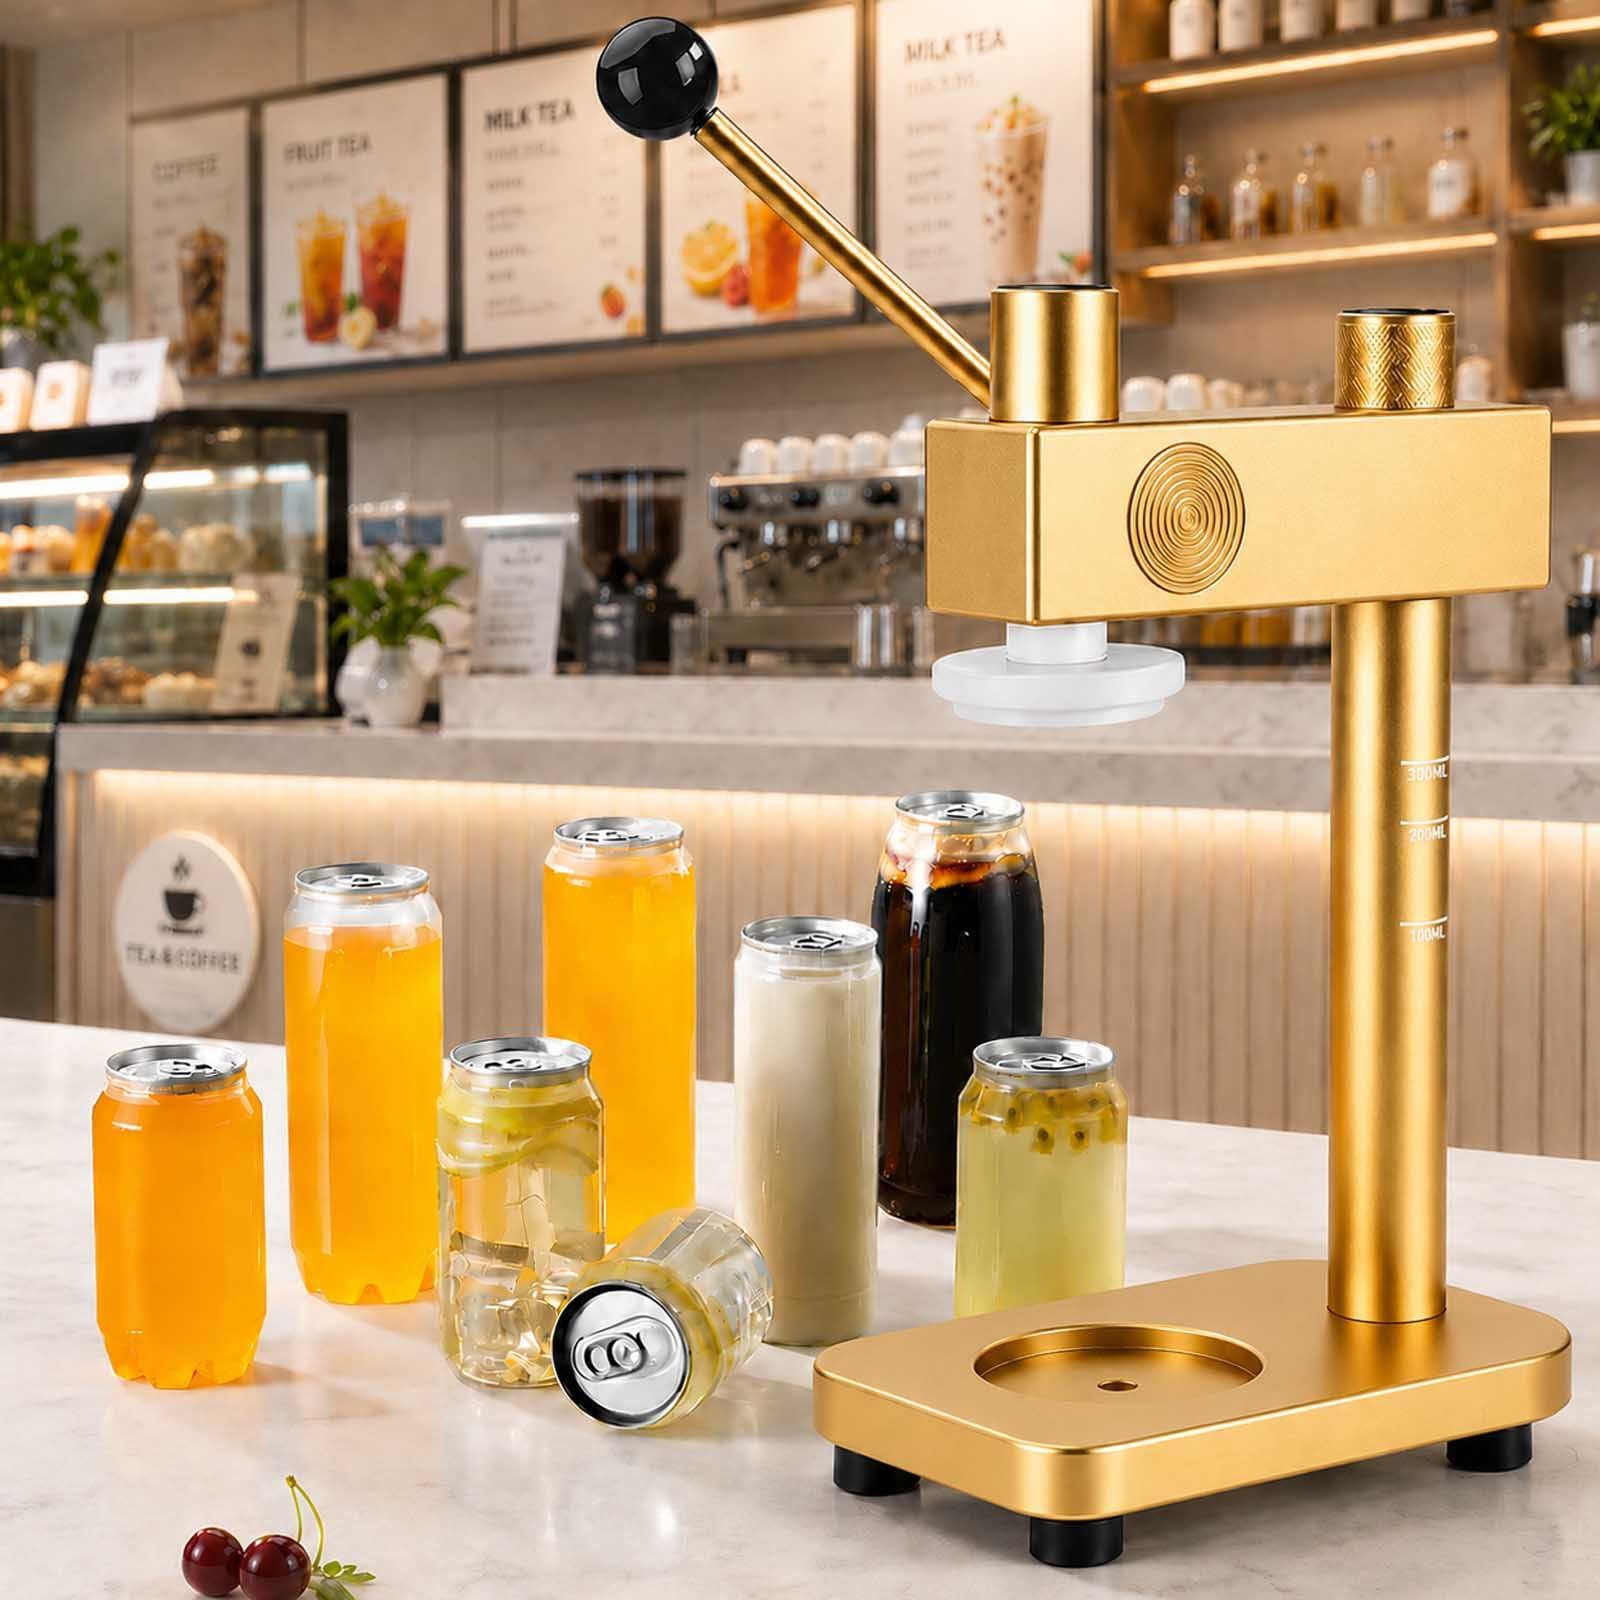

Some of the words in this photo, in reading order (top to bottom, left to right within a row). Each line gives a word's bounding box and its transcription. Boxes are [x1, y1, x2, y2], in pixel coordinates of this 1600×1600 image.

[905, 38, 957, 62] MILK
[963, 29, 1005, 53] TEA
[484, 108, 532, 131] MILK
[538, 100, 575, 124] TEA
[284, 140, 332, 165] FRUIT
[337, 133, 371, 157] TEA
[1407, 763, 1448, 782] 300ML
[1409, 823, 1447, 842] 200ML
[1410, 924, 1446, 943] 100ML
[125, 945, 159, 967] TEA
[177, 949, 240, 975] COFFEE
